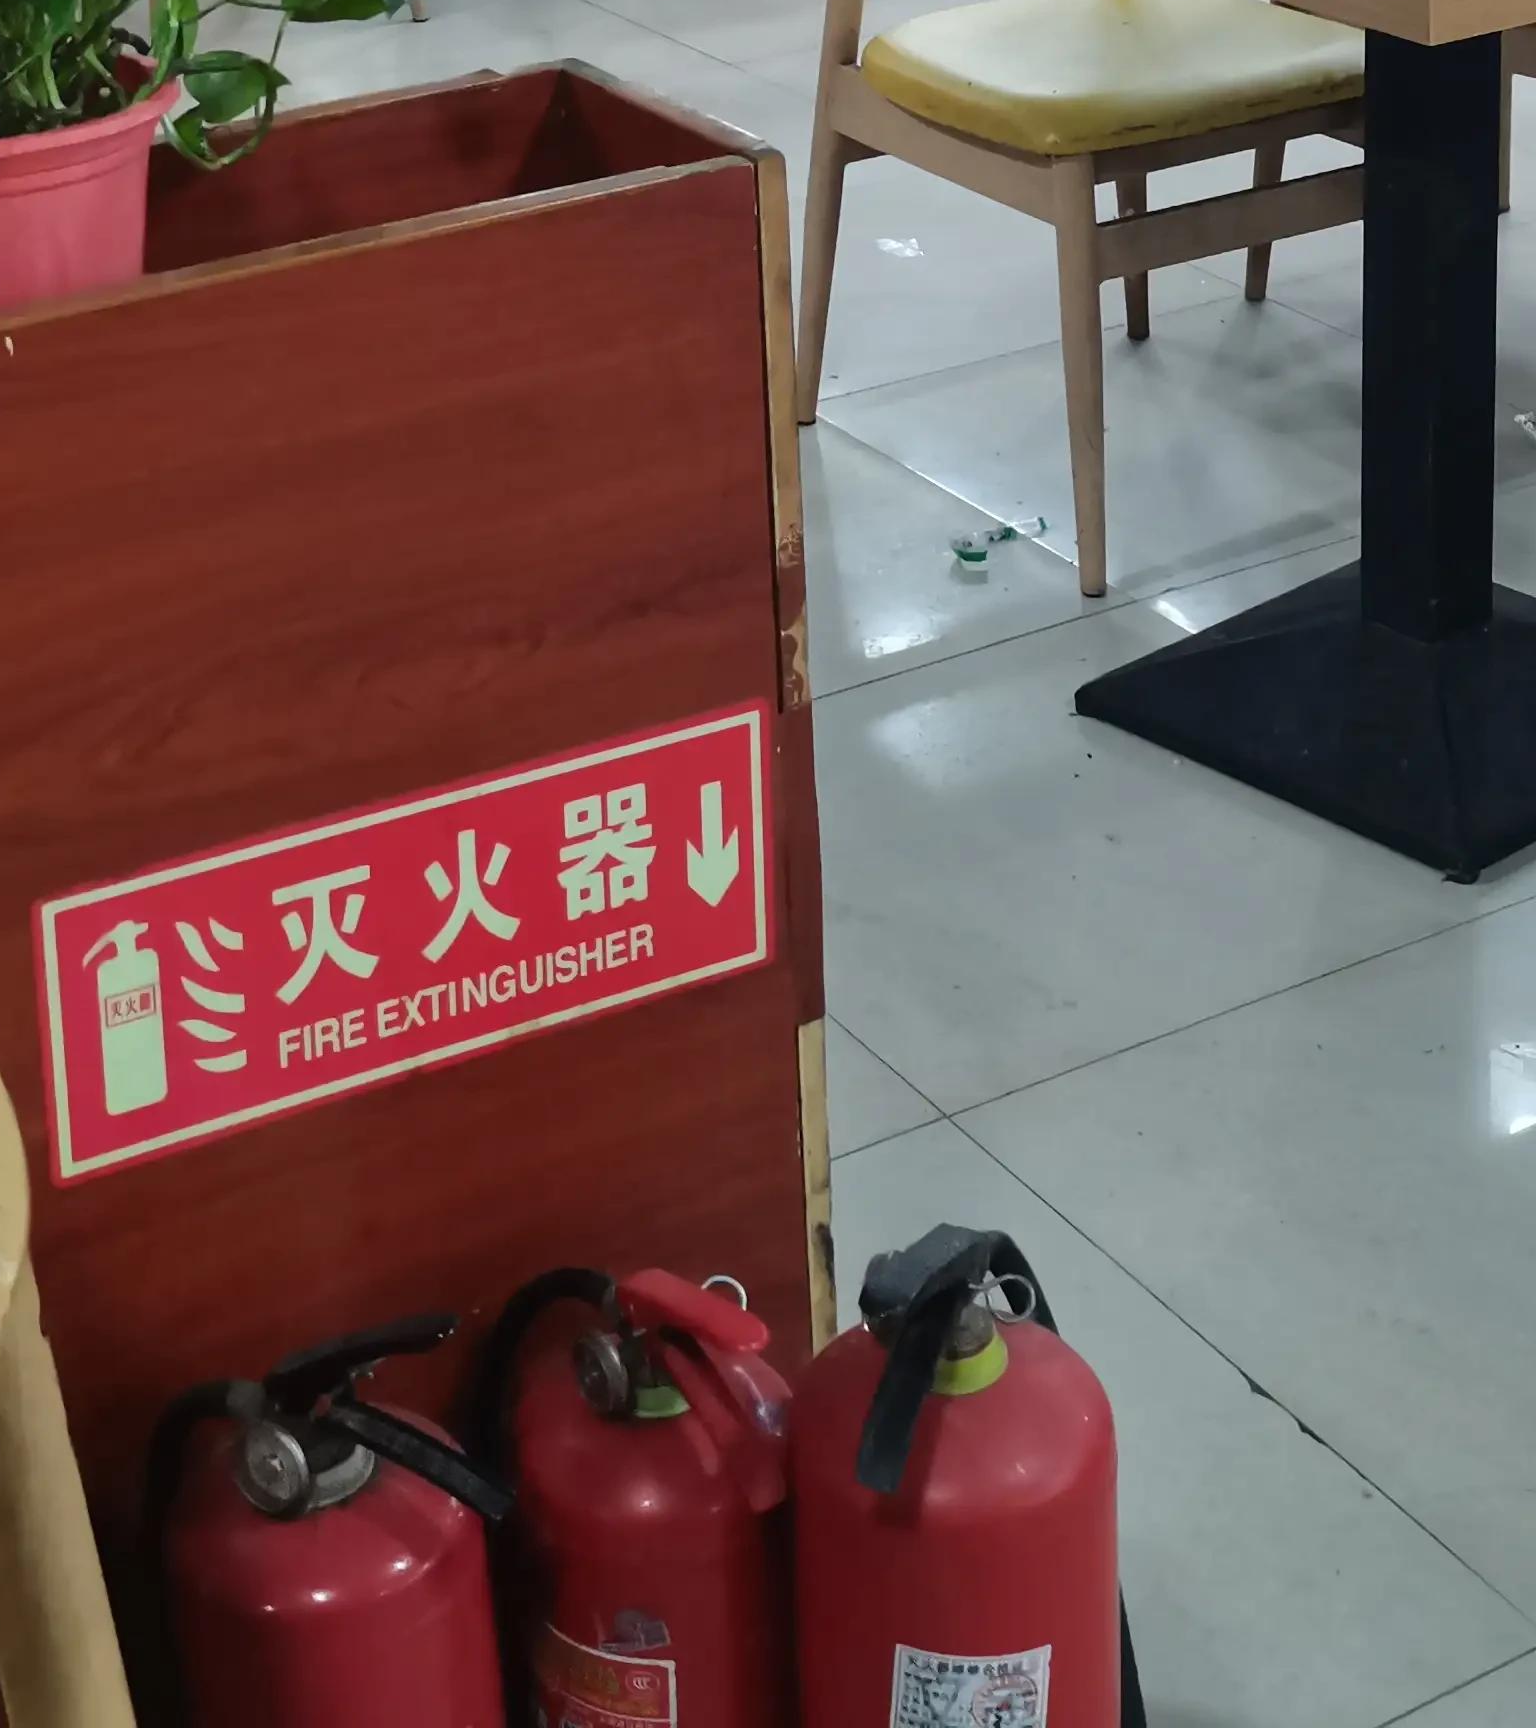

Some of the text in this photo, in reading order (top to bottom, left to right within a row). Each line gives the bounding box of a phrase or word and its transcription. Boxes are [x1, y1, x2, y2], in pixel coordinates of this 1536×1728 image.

[271, 782, 658, 1005] 灭火器
[278, 923, 655, 1069] FIRE EXTINGUISHER
